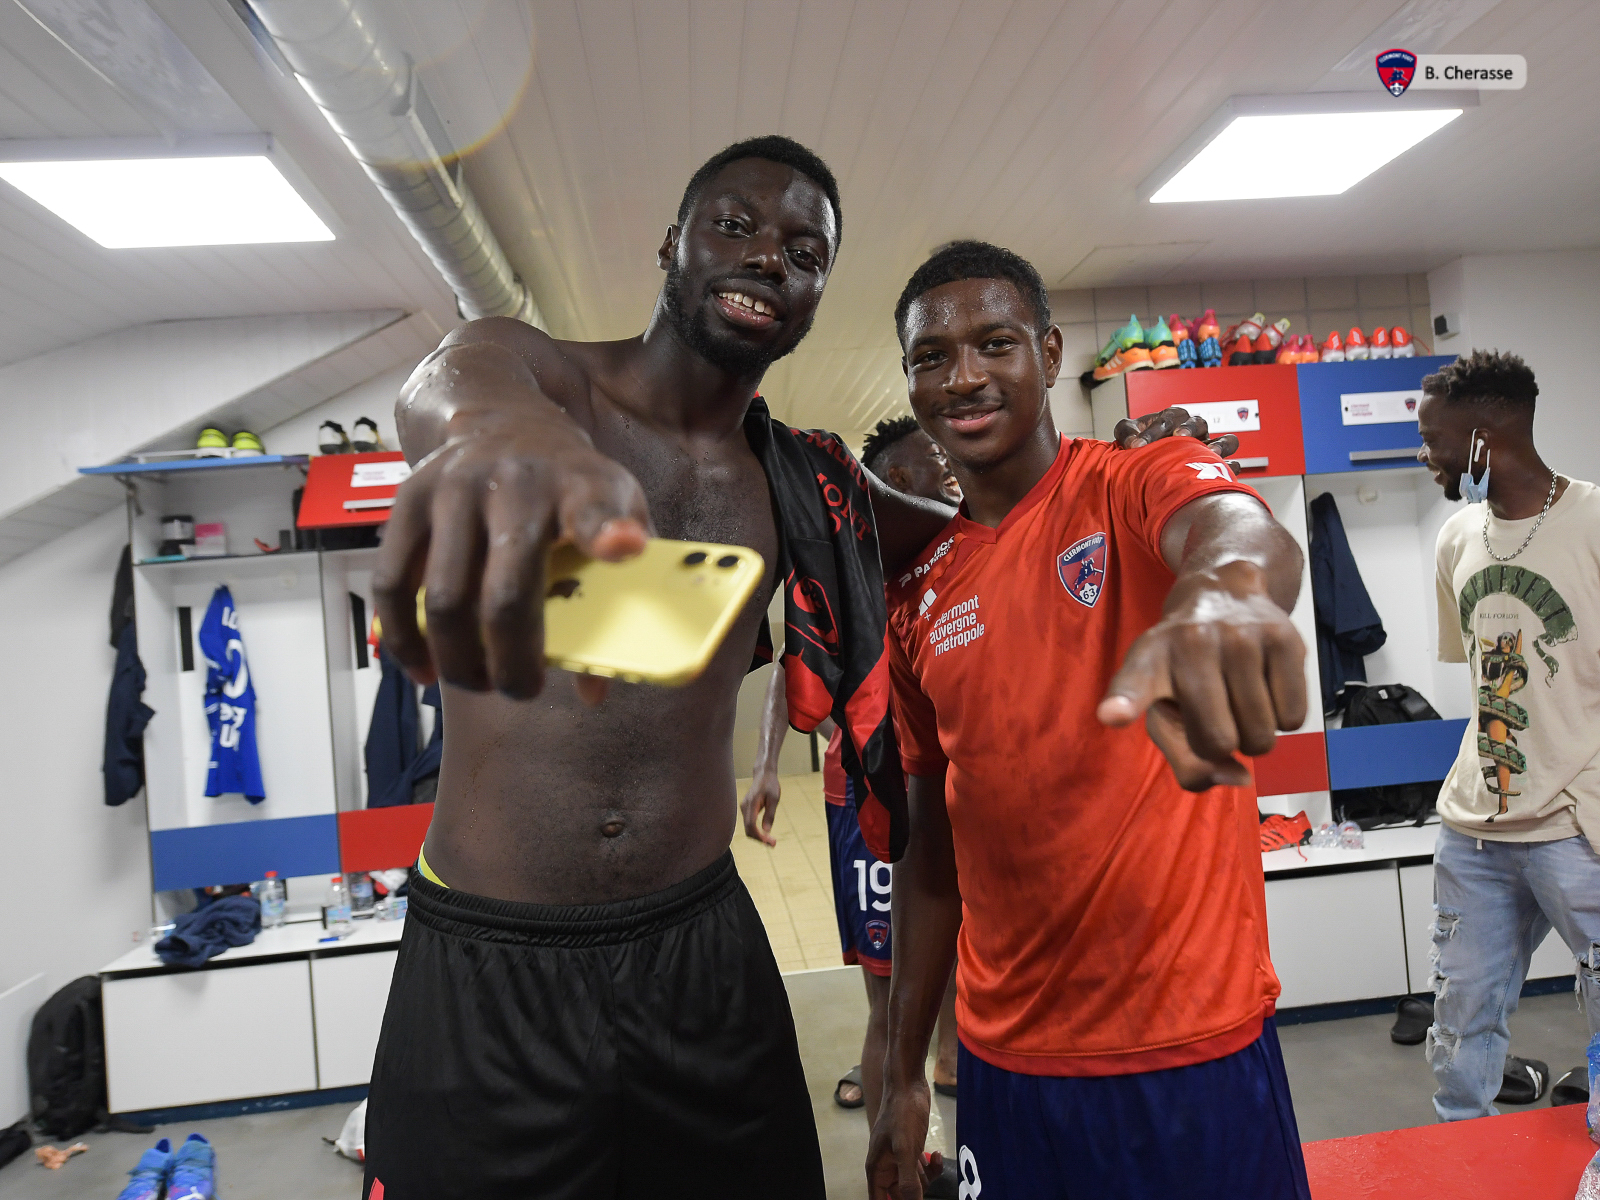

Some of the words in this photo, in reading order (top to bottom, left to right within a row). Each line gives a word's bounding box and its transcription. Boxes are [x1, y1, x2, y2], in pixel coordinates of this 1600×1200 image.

[1063, 539, 1091, 562] CLERMONT
[1083, 588, 1096, 600] 63
[929, 612, 977, 645] auvergne
[935, 622, 985, 657] métropole
[853, 859, 893, 912] 19
